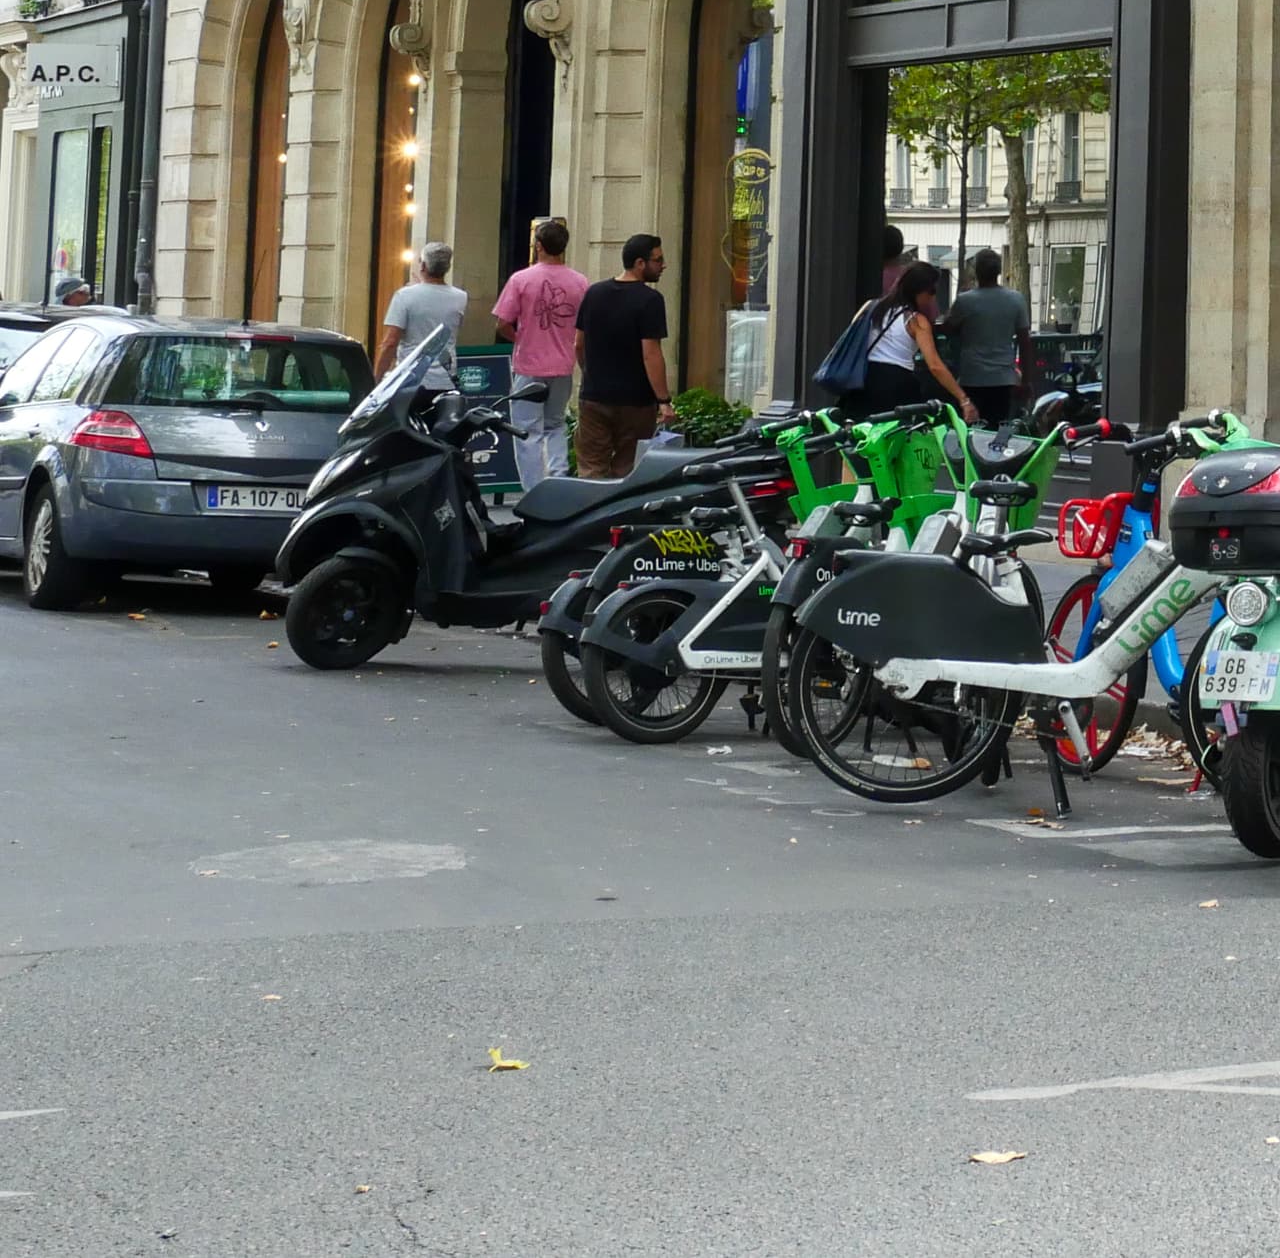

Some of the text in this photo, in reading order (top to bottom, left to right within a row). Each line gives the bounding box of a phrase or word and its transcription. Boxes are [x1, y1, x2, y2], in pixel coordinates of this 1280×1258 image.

[31, 64, 100, 83] A.P.C.
[633, 557, 654, 571] On
[655, 557, 686, 571] Lime
[816, 567, 831, 582] On
[837, 607, 881, 626] Lime
[1118, 578, 1196, 654] Lime
[703, 655, 716, 664] On
[717, 655, 734, 664] Lime
[1225, 658, 1246, 675] GB
[1204, 676, 1272, 694] 639-FM
